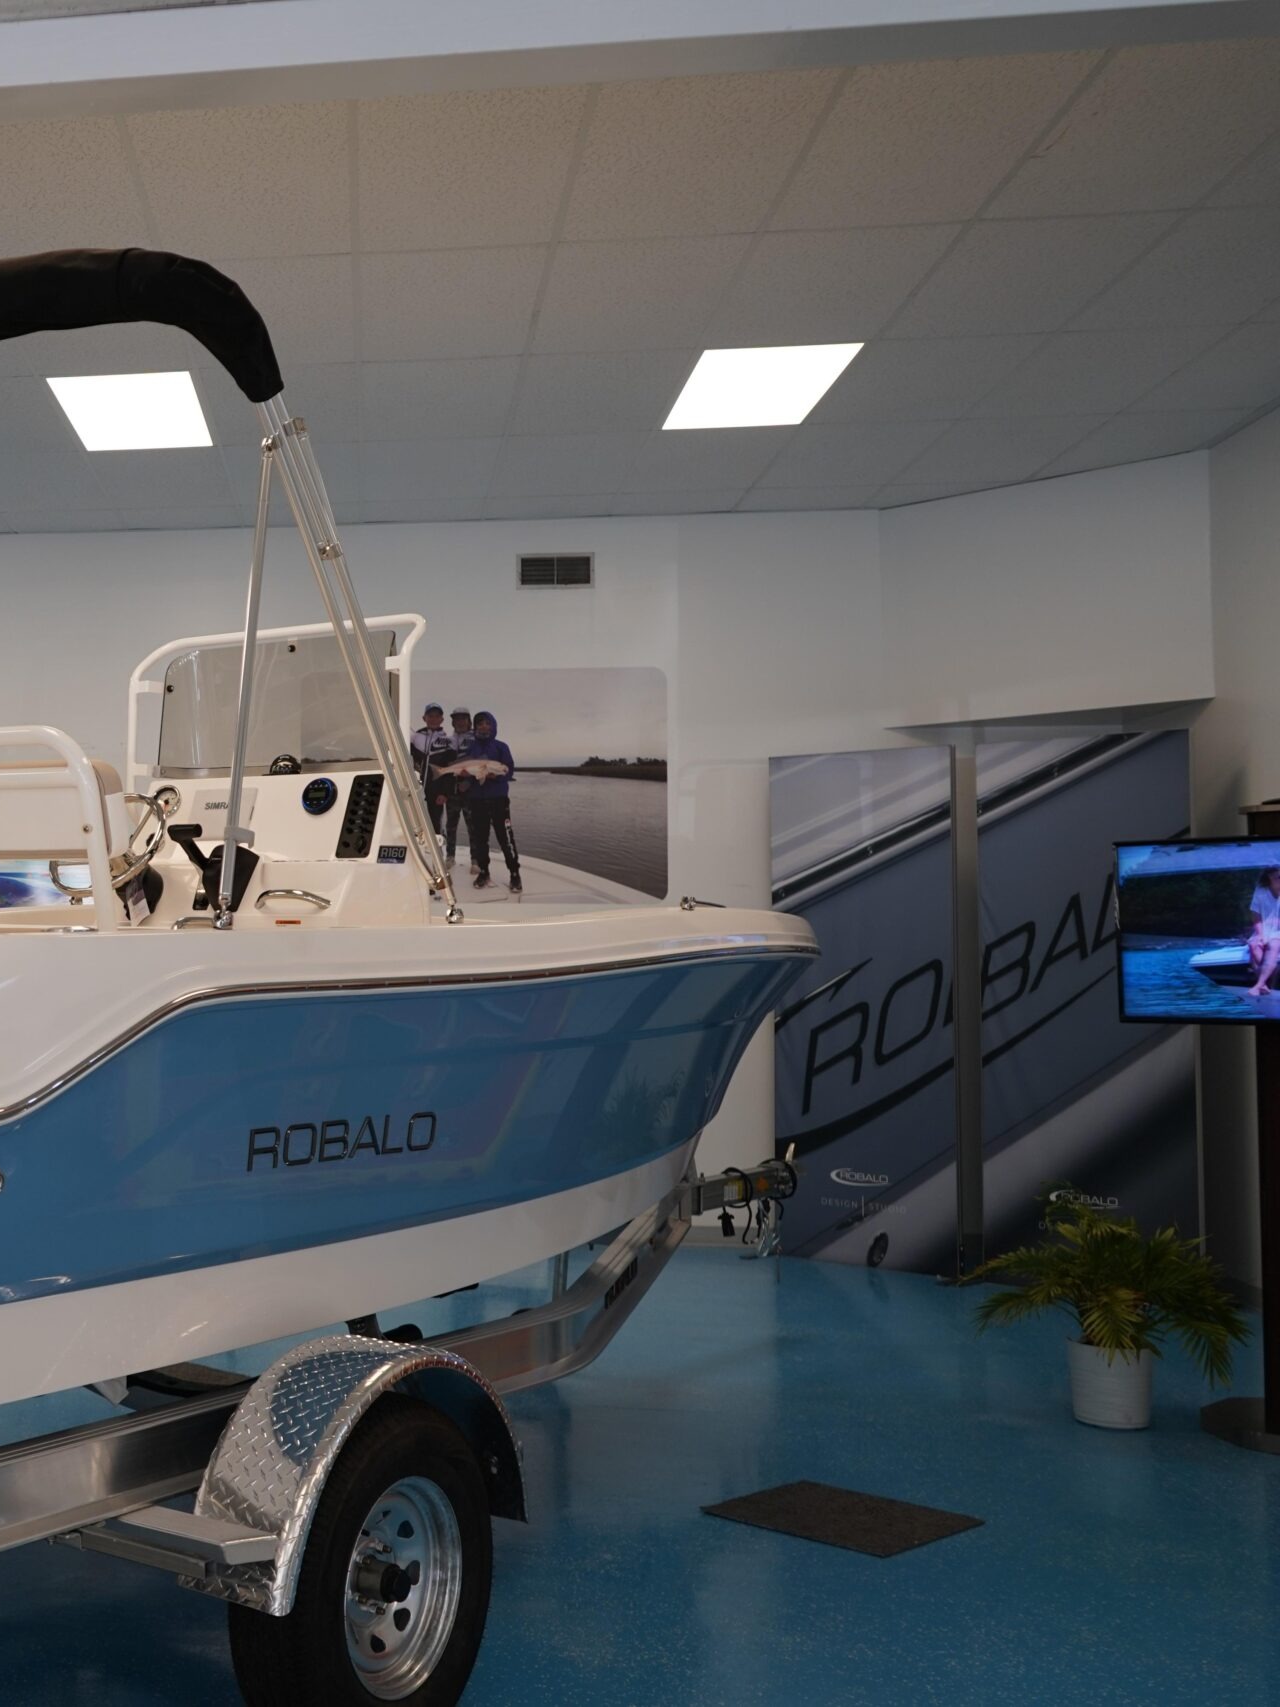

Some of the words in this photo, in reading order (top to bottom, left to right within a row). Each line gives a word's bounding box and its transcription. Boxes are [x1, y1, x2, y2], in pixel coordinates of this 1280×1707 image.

[801, 872, 1120, 1117] ROBAL
[246, 1111, 437, 1173] ROBALO
[820, 1197, 858, 1209] DESIGN
